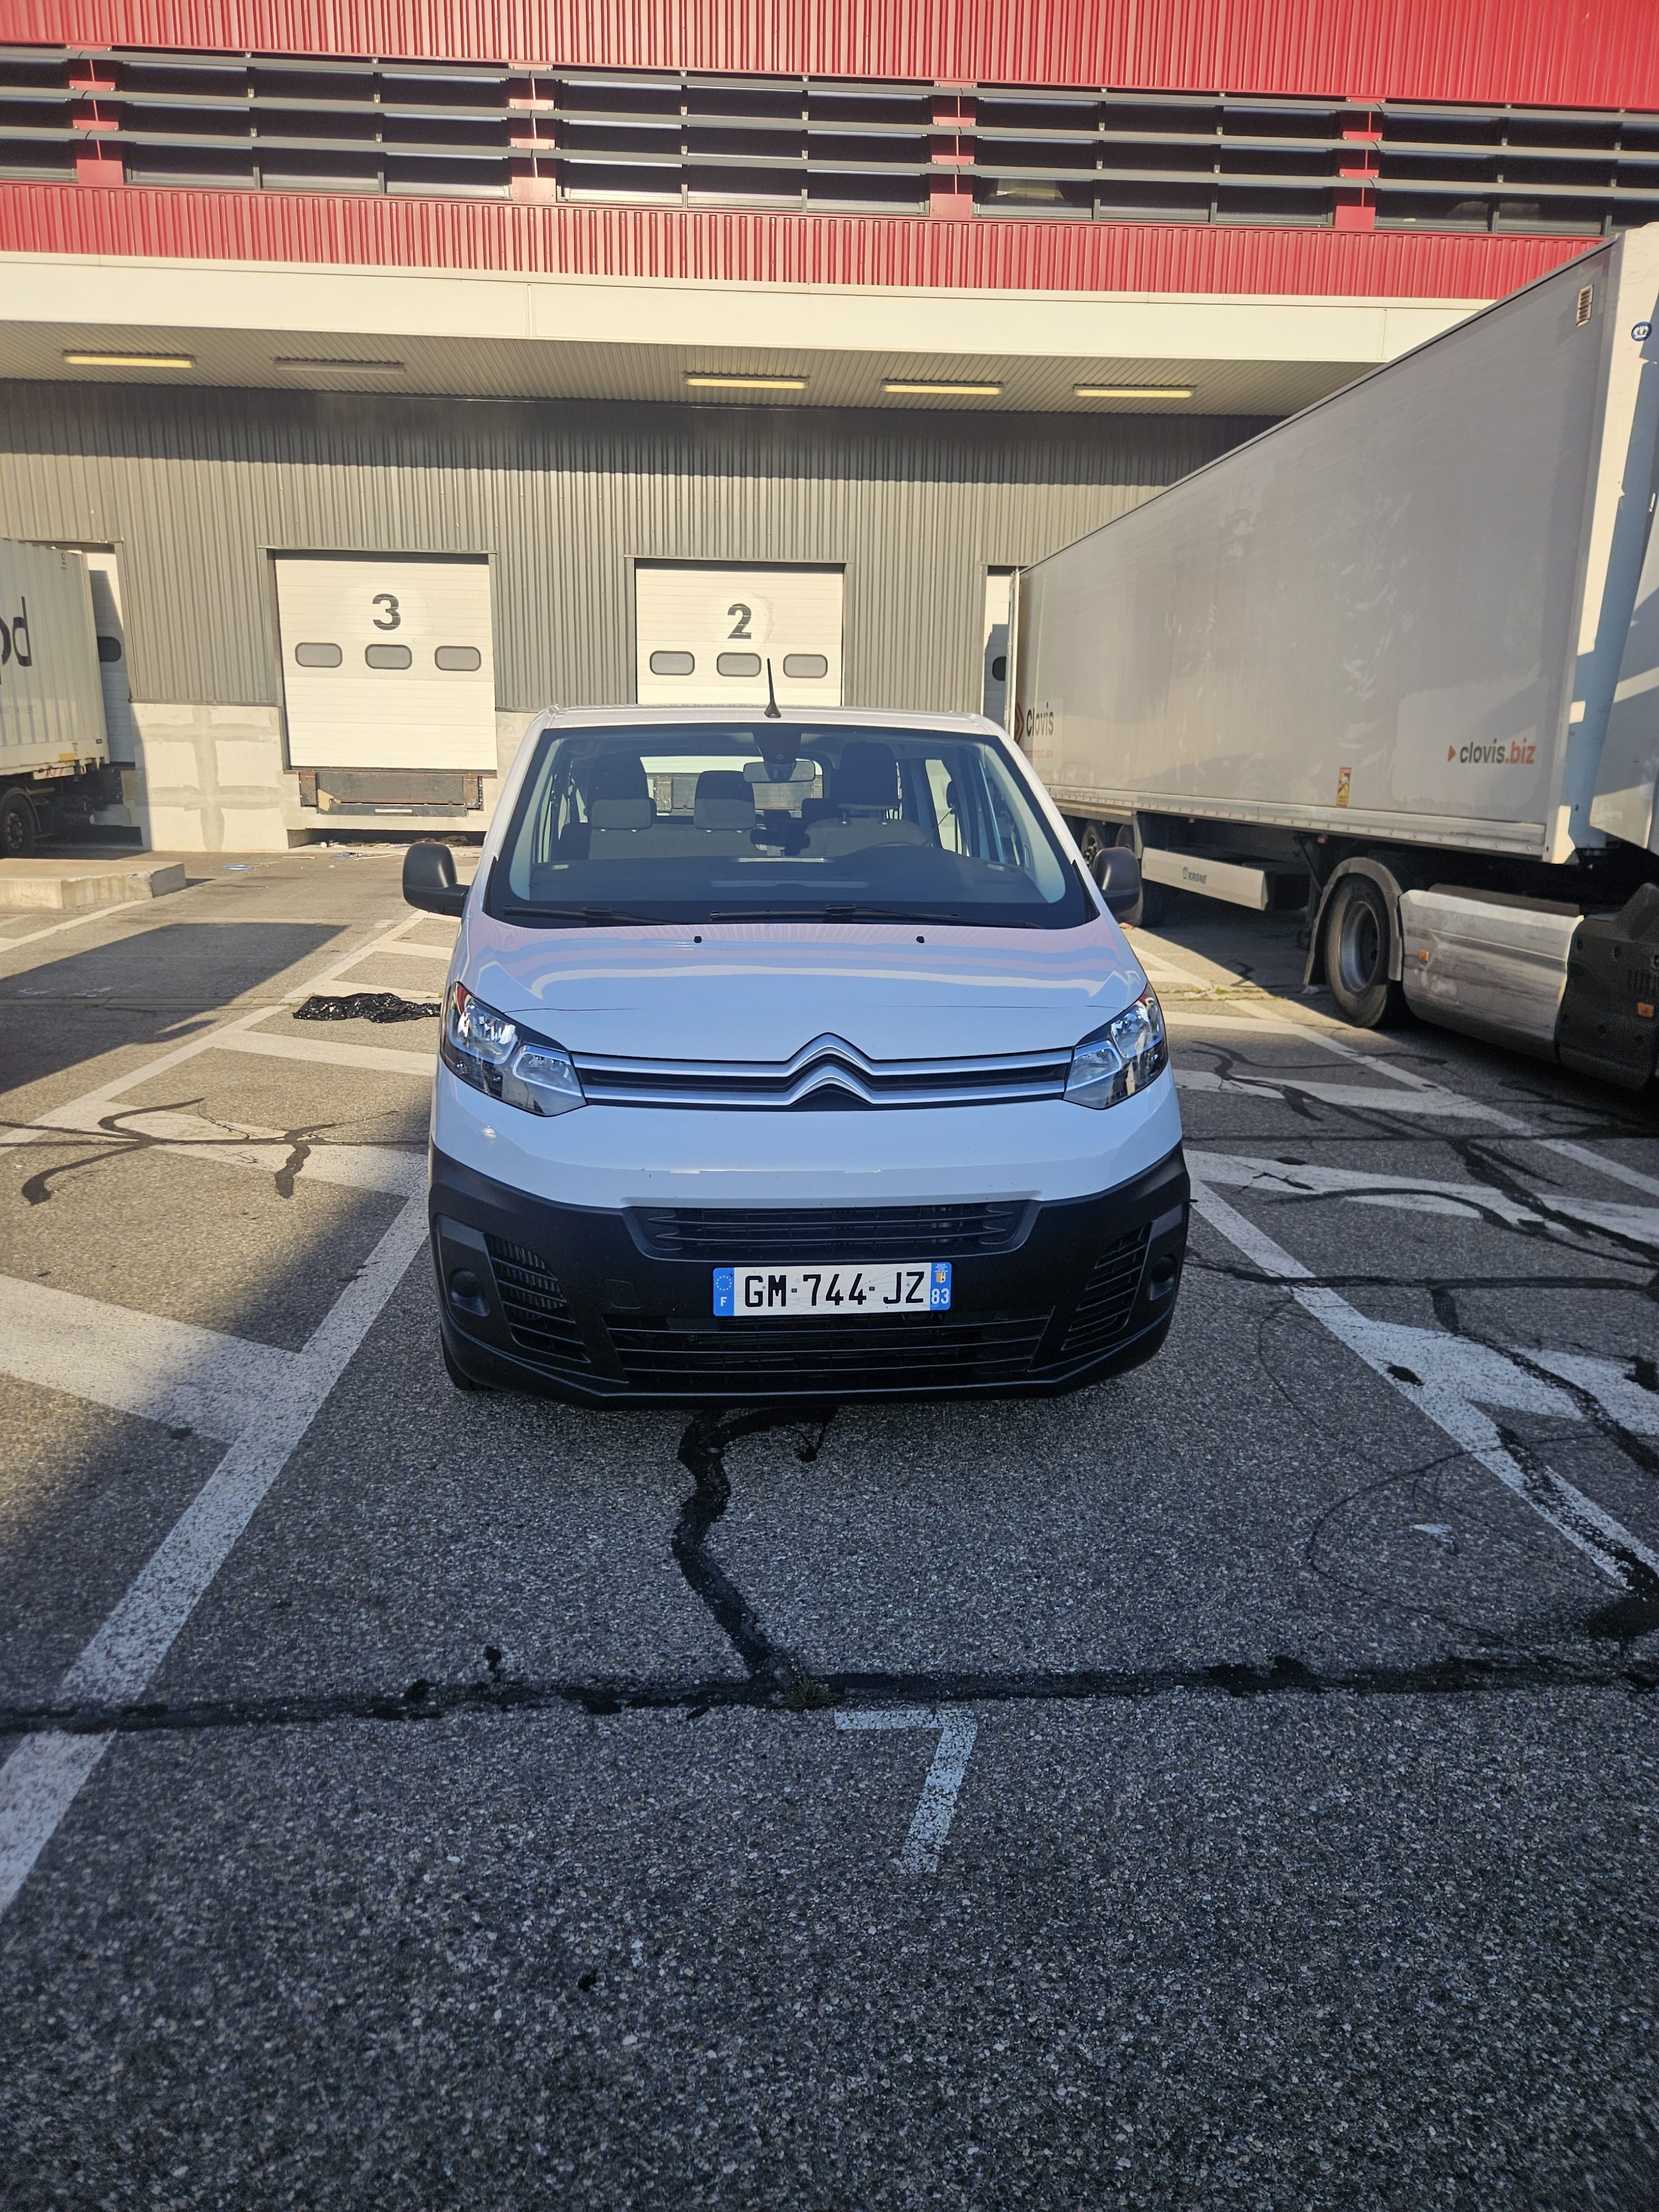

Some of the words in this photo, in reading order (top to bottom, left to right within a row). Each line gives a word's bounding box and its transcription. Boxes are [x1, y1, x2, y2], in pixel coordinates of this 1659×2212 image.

[372, 593, 401, 630] 3
[727, 603, 752, 639] 2
[1460, 737, 1536, 764] clovis.biz
[1188, 872, 1207, 884] KRONE
[720, 1296, 728, 1307] F
[744, 1271, 925, 1308] GM-744-JZ
[931, 1287, 950, 1305] 83
